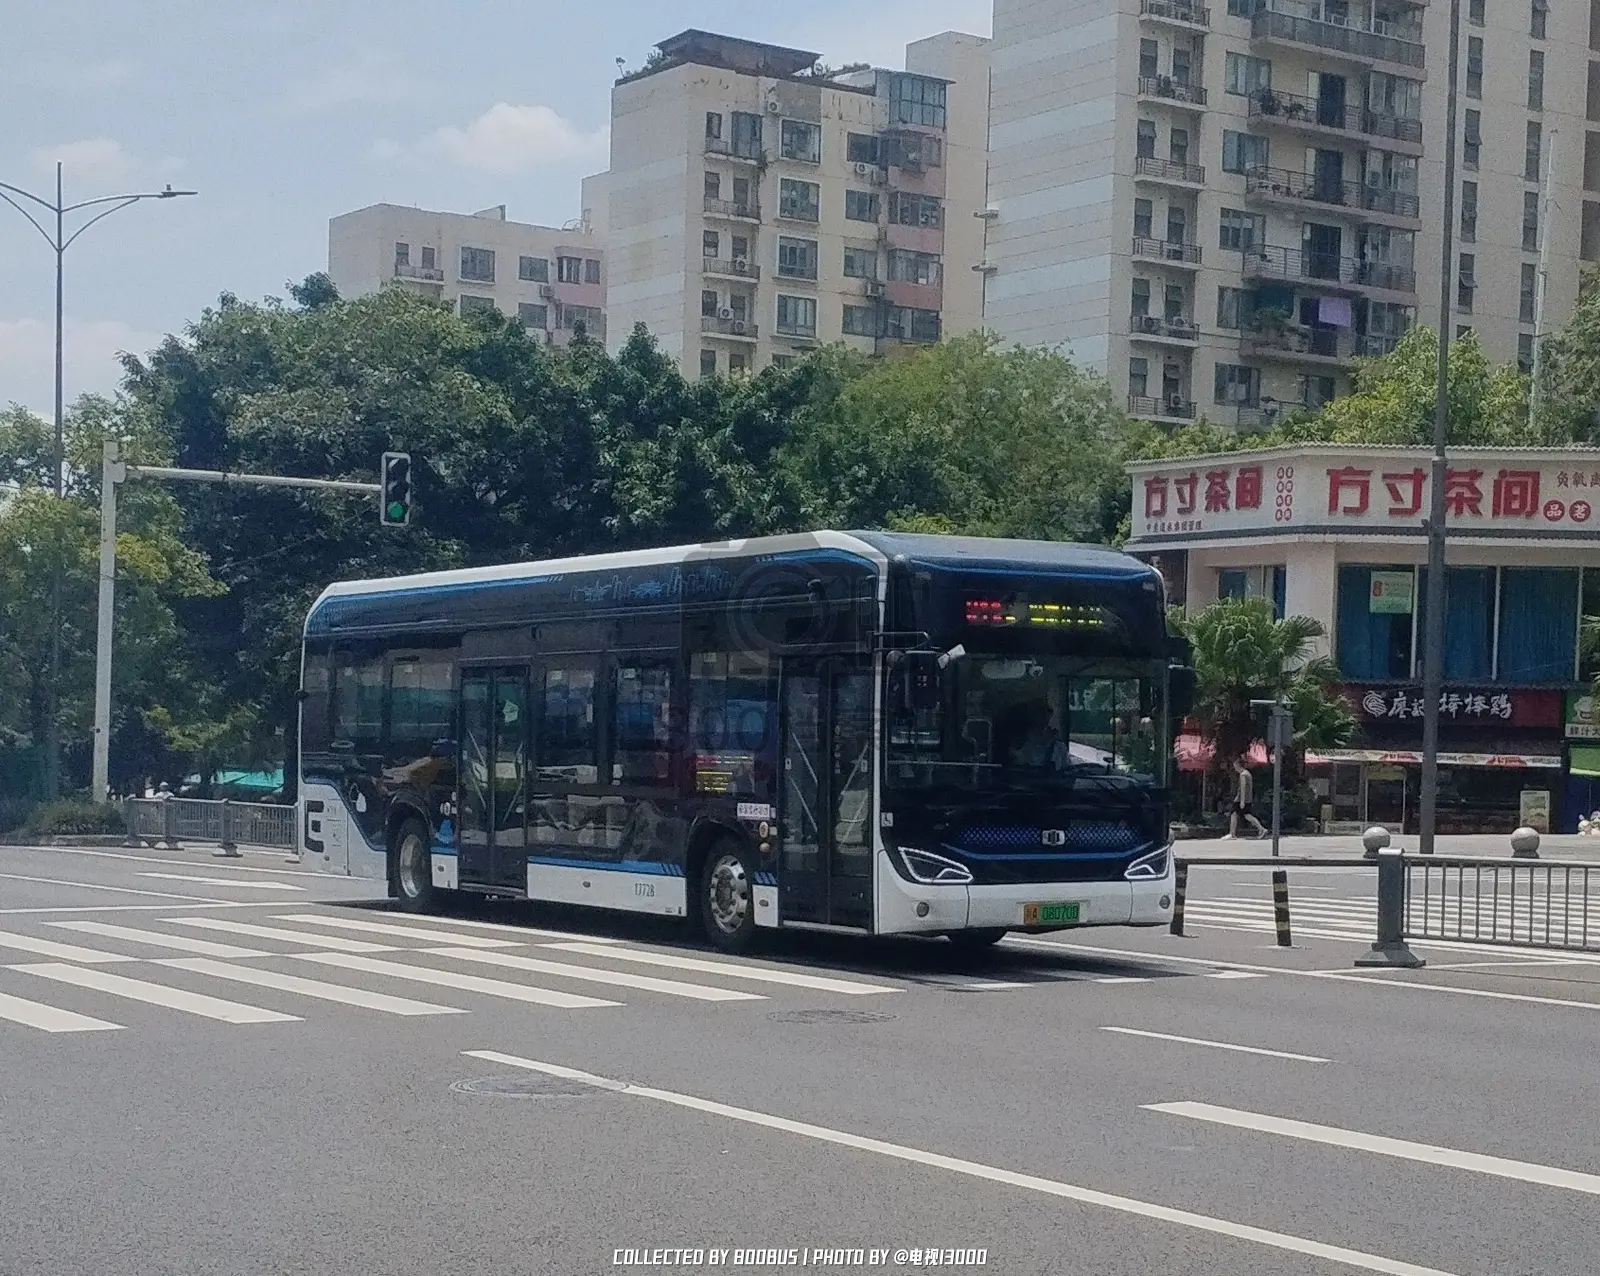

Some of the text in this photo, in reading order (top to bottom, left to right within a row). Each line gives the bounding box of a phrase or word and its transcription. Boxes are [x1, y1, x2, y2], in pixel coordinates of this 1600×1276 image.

[1144, 466, 1263, 518] 方寸茶间
[1326, 466, 1541, 518] 方寸茶间
